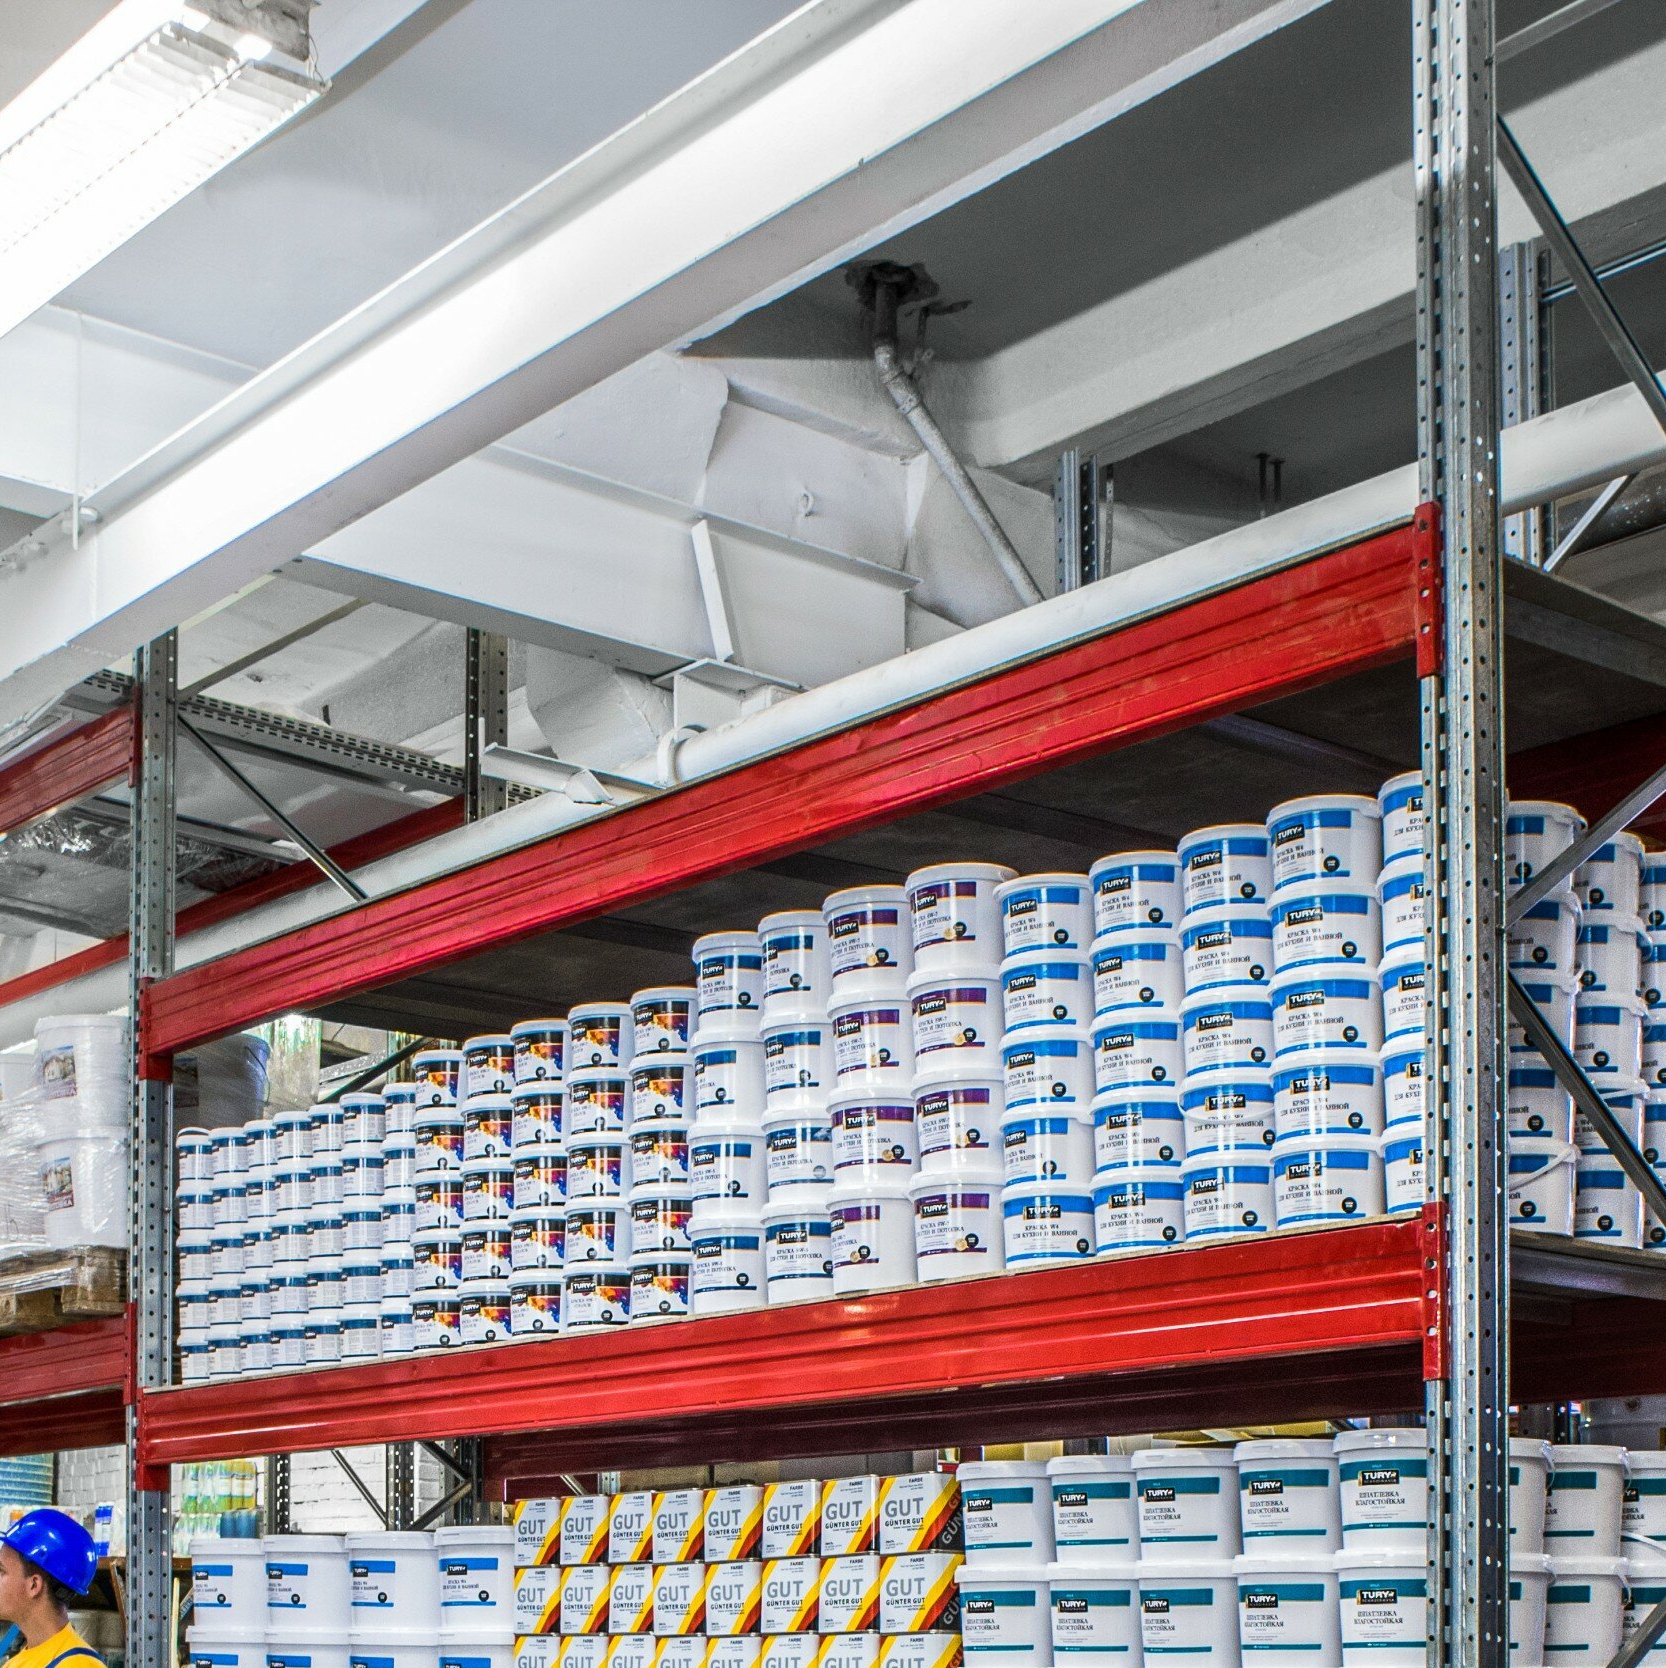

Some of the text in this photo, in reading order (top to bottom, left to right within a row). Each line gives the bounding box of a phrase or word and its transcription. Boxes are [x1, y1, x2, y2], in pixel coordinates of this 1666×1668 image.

[1278, 826, 1297, 839] TURY
[1104, 880, 1123, 890] TURY
[1289, 909, 1315, 920] TURY
[1290, 994, 1317, 1003] TURY
[1201, 1016, 1224, 1025] TURY
[923, 1205, 942, 1213] TURY
[826, 1501, 862, 1520] GUT
[885, 1498, 923, 1517] GUT
[708, 1509, 741, 1528] GUT
[767, 1505, 803, 1523] GUT
[565, 1517, 593, 1532] GUT
[614, 1514, 644, 1530] GUT
[657, 1512, 688, 1530] GUT
[767, 1523, 790, 1531] GÜNTER
[825, 1521, 849, 1529] GÜNTER
[885, 1518, 910, 1526] GÜNTER
[518, 1520, 545, 1535] GUT
[657, 1530, 678, 1538] GÜNTER
[886, 1578, 924, 1597] GUT
[886, 1598, 911, 1606] GÜNTER
